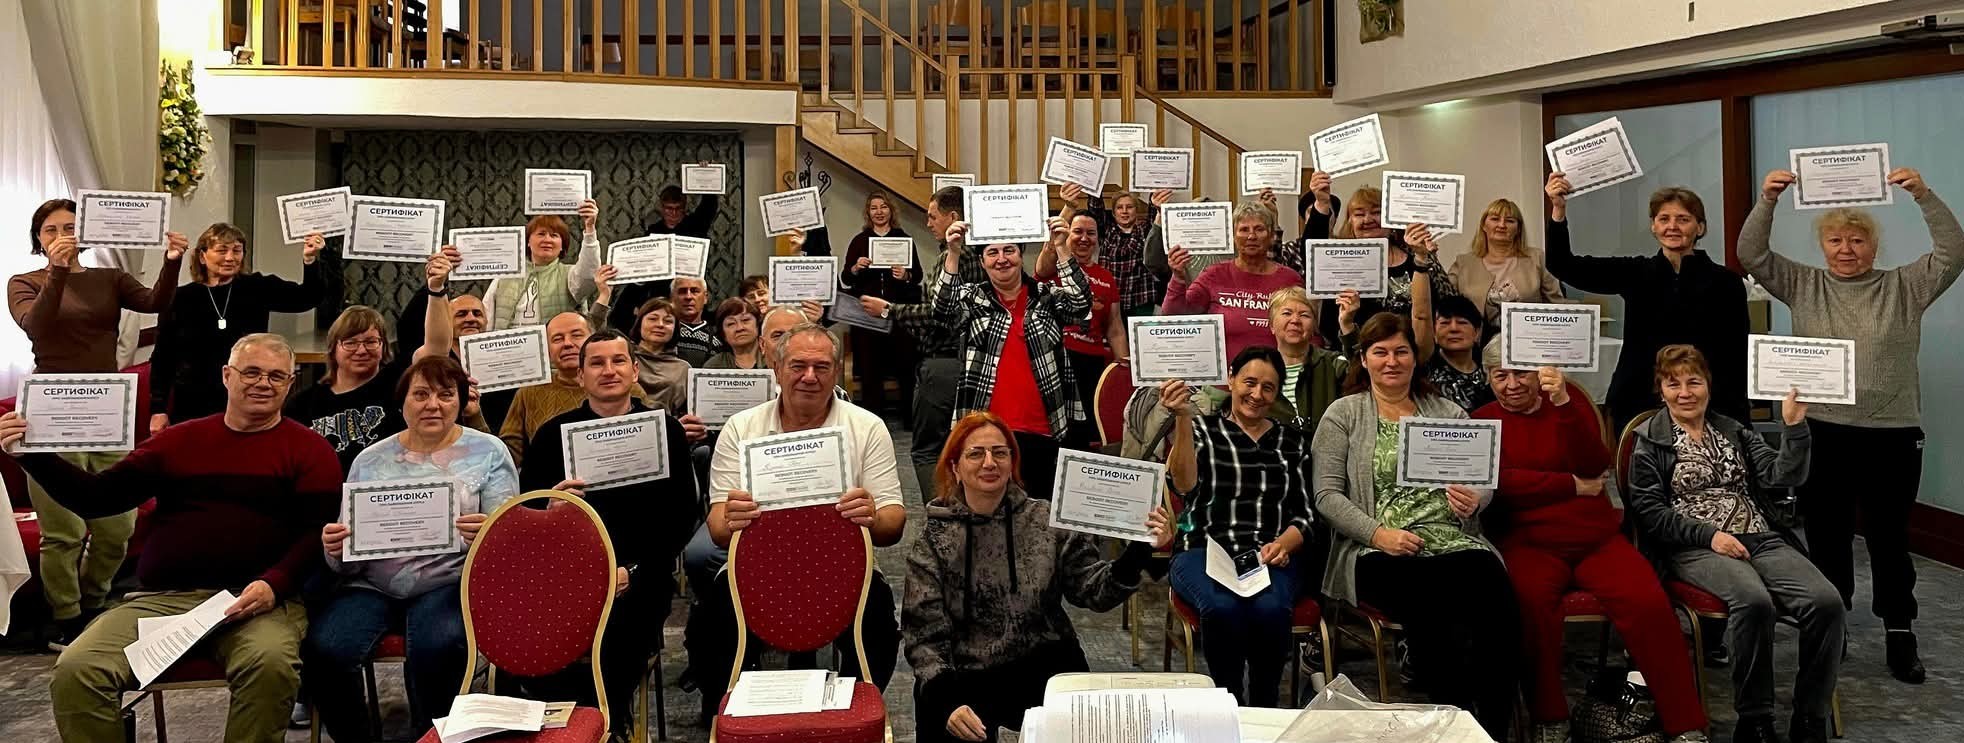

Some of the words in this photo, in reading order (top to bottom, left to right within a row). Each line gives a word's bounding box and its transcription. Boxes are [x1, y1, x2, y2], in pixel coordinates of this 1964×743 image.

[1324, 127, 1364, 144] СЕРТИФІКАТ
[1564, 137, 1608, 156] СЕРТИФІКАТ
[1062, 148, 1097, 162] СЕРТИФІКАТ
[1811, 155, 1867, 165] СЕРТИФІКАТ
[1399, 182, 1446, 191] СЕРТИФІКАТ
[295, 197, 336, 208] СЕРТИФІКАТ
[982, 194, 1029, 202] СЕРТИФІКАТ
[97, 200, 150, 209] СЕРТИФІКАТ
[369, 208, 424, 217] СЕРТИФІКАТ
[1176, 210, 1217, 218] СЕРТИФІКАТ
[465, 263, 509, 271] СЕРТИФІКАТ
[784, 264, 824, 272] СЕРТИФІКАТ
[1219, 297, 1241, 308] SAN
[1243, 299, 1270, 310] FRAN
[1523, 315, 1579, 324] СЕРТИФІКАТ
[1148, 328, 1202, 336] СЕРТИФІКАТ
[478, 337, 528, 351] СЕРТИФІКАТ
[1771, 346, 1831, 356] СЕРТИФІКАТ
[707, 380, 757, 388] СЕРТИФІКАТ
[42, 387, 110, 396] СЕРТИФІКАТ
[585, 426, 643, 441] СЕРТИФІКАТ
[1422, 430, 1479, 439] СЕРТИФІКАТ
[763, 441, 825, 457] СЕРТИФІКАТ
[1080, 466, 1141, 483] СЕРТИФІКАТ
[369, 492, 435, 503] СЕРТИФІКАТ
